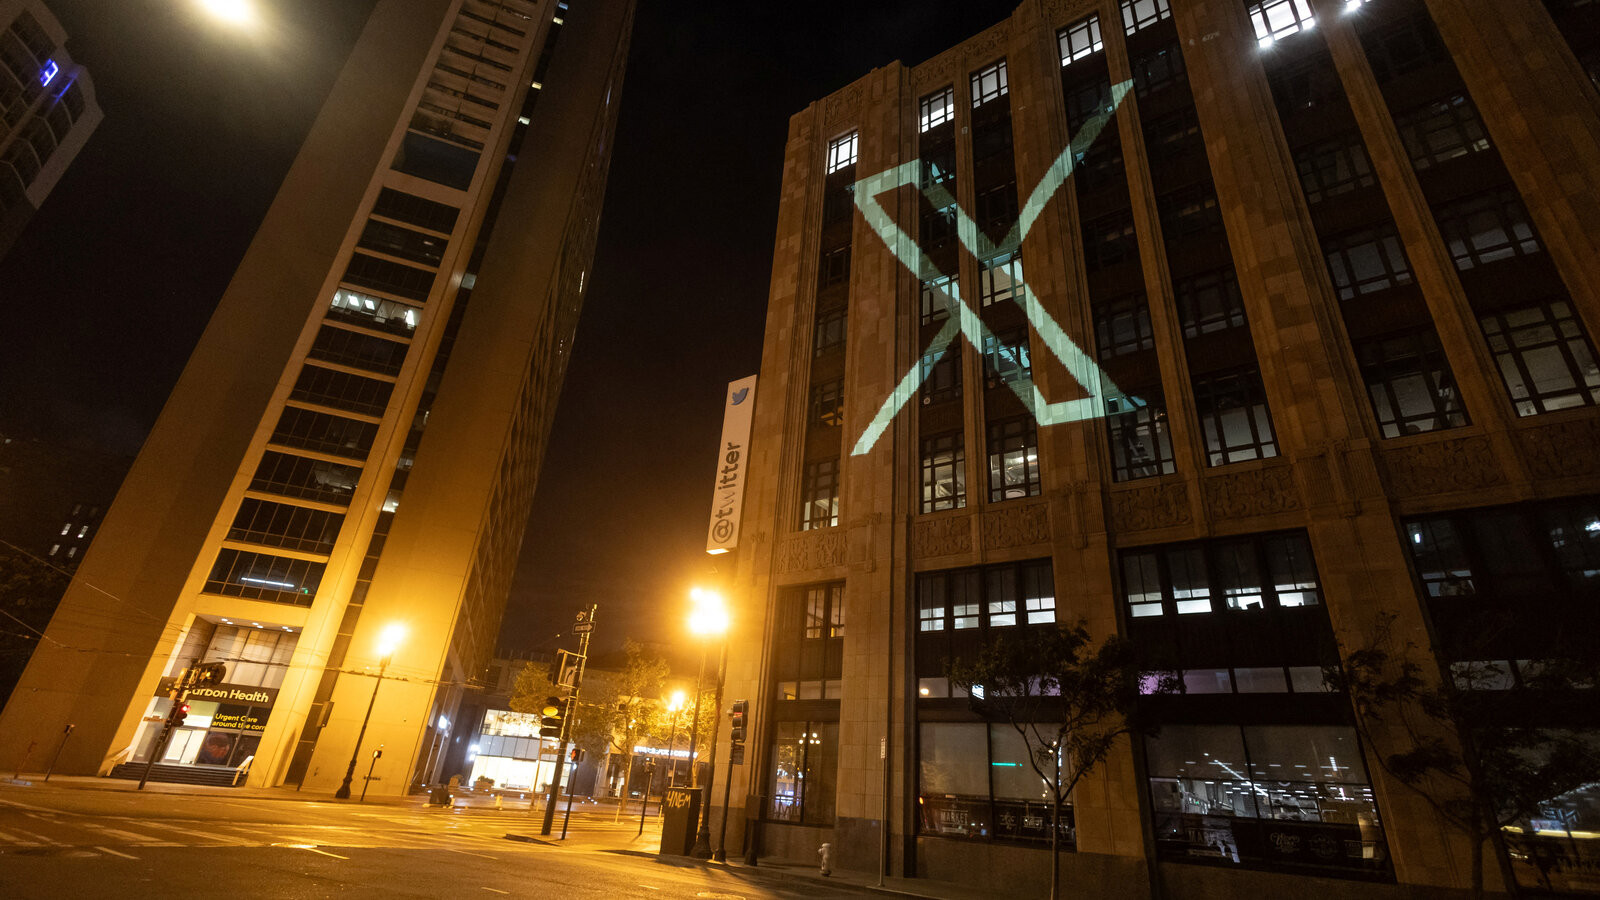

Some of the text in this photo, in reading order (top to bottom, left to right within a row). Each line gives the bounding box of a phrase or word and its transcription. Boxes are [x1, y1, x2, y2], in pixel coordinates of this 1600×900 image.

[190, 688, 269, 702] arbon Health
[215, 713, 258, 723] Urgent Care
[211, 720, 238, 728] around
